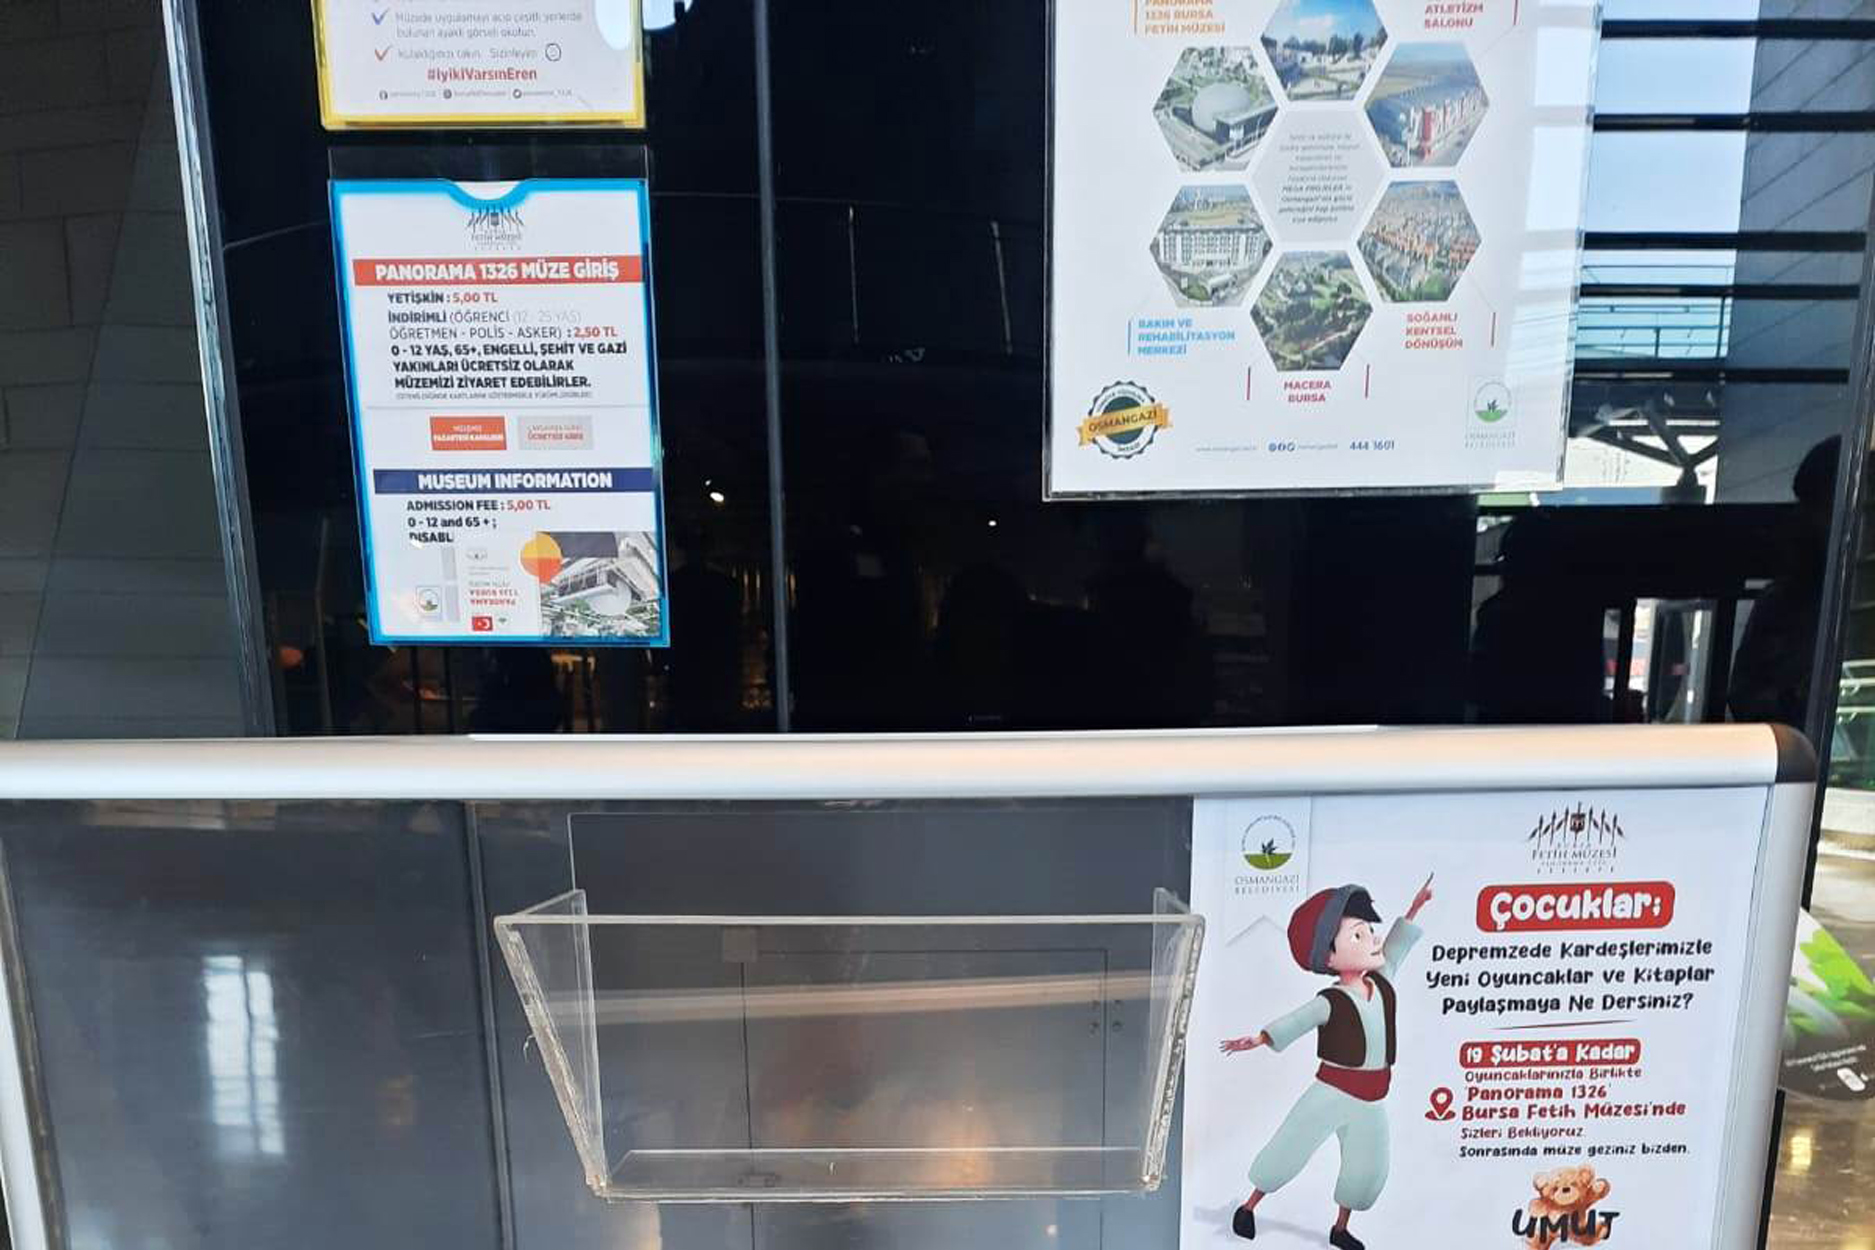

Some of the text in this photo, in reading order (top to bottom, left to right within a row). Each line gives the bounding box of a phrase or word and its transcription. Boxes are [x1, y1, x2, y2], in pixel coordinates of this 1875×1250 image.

[375, 258, 619, 281] PANORAMA 1326 MÜZE GİRİŞ
[388, 290, 444, 305] YETİŞKİN
[452, 293, 481, 306] 5,00
[483, 292, 499, 304] TL
[388, 309, 447, 324] İNDİRİMLİ
[1178, 318, 1193, 328] VE
[1407, 311, 1458, 323] SOĞANLI
[389, 324, 458, 340] ÖĞRETMEN
[469, 324, 505, 339] POLİS
[516, 326, 562, 339] ASKER)
[574, 326, 601, 340] 2,50
[603, 326, 618, 338] TL
[1138, 330, 1236, 342] REHABİLİTASYON
[1405, 326, 1457, 336] KENTSEL
[409, 344, 422, 356] 12
[424, 343, 453, 358] YAŞ,
[483, 341, 539, 356] ENGELLİ,
[540, 340, 576, 357] ŞEHİT
[578, 342, 595, 354] VE
[597, 340, 627, 355] GAZİ
[1138, 343, 1188, 355] MERKEZİ
[1405, 338, 1463, 350] DÖNÜŞÜM
[393, 358, 574, 373] YAKINLARI ÜCRETSİZ OLARAK
[395, 373, 592, 389] MÜZEMİZİ ZİYARET EDEBİLİRLER.
[1283, 380, 1332, 391] MACERA
[1288, 394, 1326, 404] BURSA
[1088, 407, 1158, 433] OSMANGAZİ
[1350, 441, 1370, 451] 444
[1373, 440, 1396, 451] 1601
[418, 471, 614, 490] MUSEUM INFORMATION
[407, 499, 475, 512] ADMISSION
[476, 499, 499, 511] FEE
[507, 499, 534, 512] 5,00
[408, 516, 416, 528] 0
[426, 516, 439, 528] 12
[440, 516, 464, 528] and
[465, 516, 480, 528] 65
[1431, 939, 1713, 964] Depremzede Kardeşlerimizle
[1426, 966, 1715, 990] Yeni Oyuncaklar ve Kitaplar
[1442, 991, 1695, 1016] Paylaşmaya Ne Dersiniz?
[1466, 1043, 1636, 1066] 19 Şubat'a Kadar
[1464, 1066, 1643, 1083] Oyuncaklarınızla Birlikte
[1462, 1100, 1687, 1121] Bursa Fetih Müzesi'nde
[1460, 1126, 1502, 1140] Sizleri
[1458, 1145, 1538, 1159] Sonrasında
[1542, 1144, 1583, 1157] müze
[1587, 1143, 1637, 1158] geziniz
[1511, 1208, 1621, 1245] UMUT
